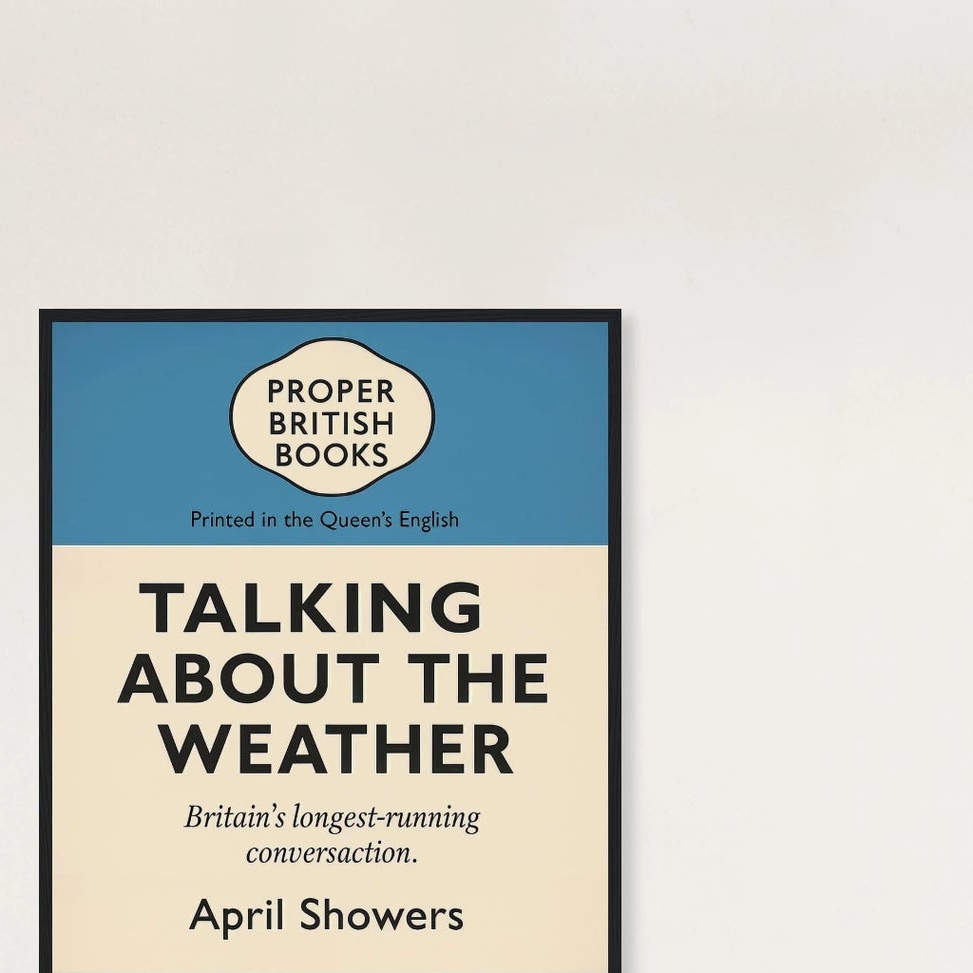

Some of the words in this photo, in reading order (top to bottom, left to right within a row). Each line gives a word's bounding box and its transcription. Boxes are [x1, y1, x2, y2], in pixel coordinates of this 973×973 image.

[269, 379, 394, 403] PROPER
[270, 411, 392, 435] BRITISH
[277, 443, 388, 467] BOOKS
[192, 511, 254, 527] Printed
[262, 512, 276, 527] in
[284, 511, 313, 527] the
[400, 511, 458, 532] English
[139, 582, 479, 633] TALKING
[117, 653, 379, 704] ABOUT
[408, 654, 547, 703] THE
[157, 724, 513, 774] WEATHER
[293, 803, 481, 834] longest-running
[247, 840, 417, 863] conversaction.
[189, 899, 282, 940] April
[301, 898, 463, 930] Showers
